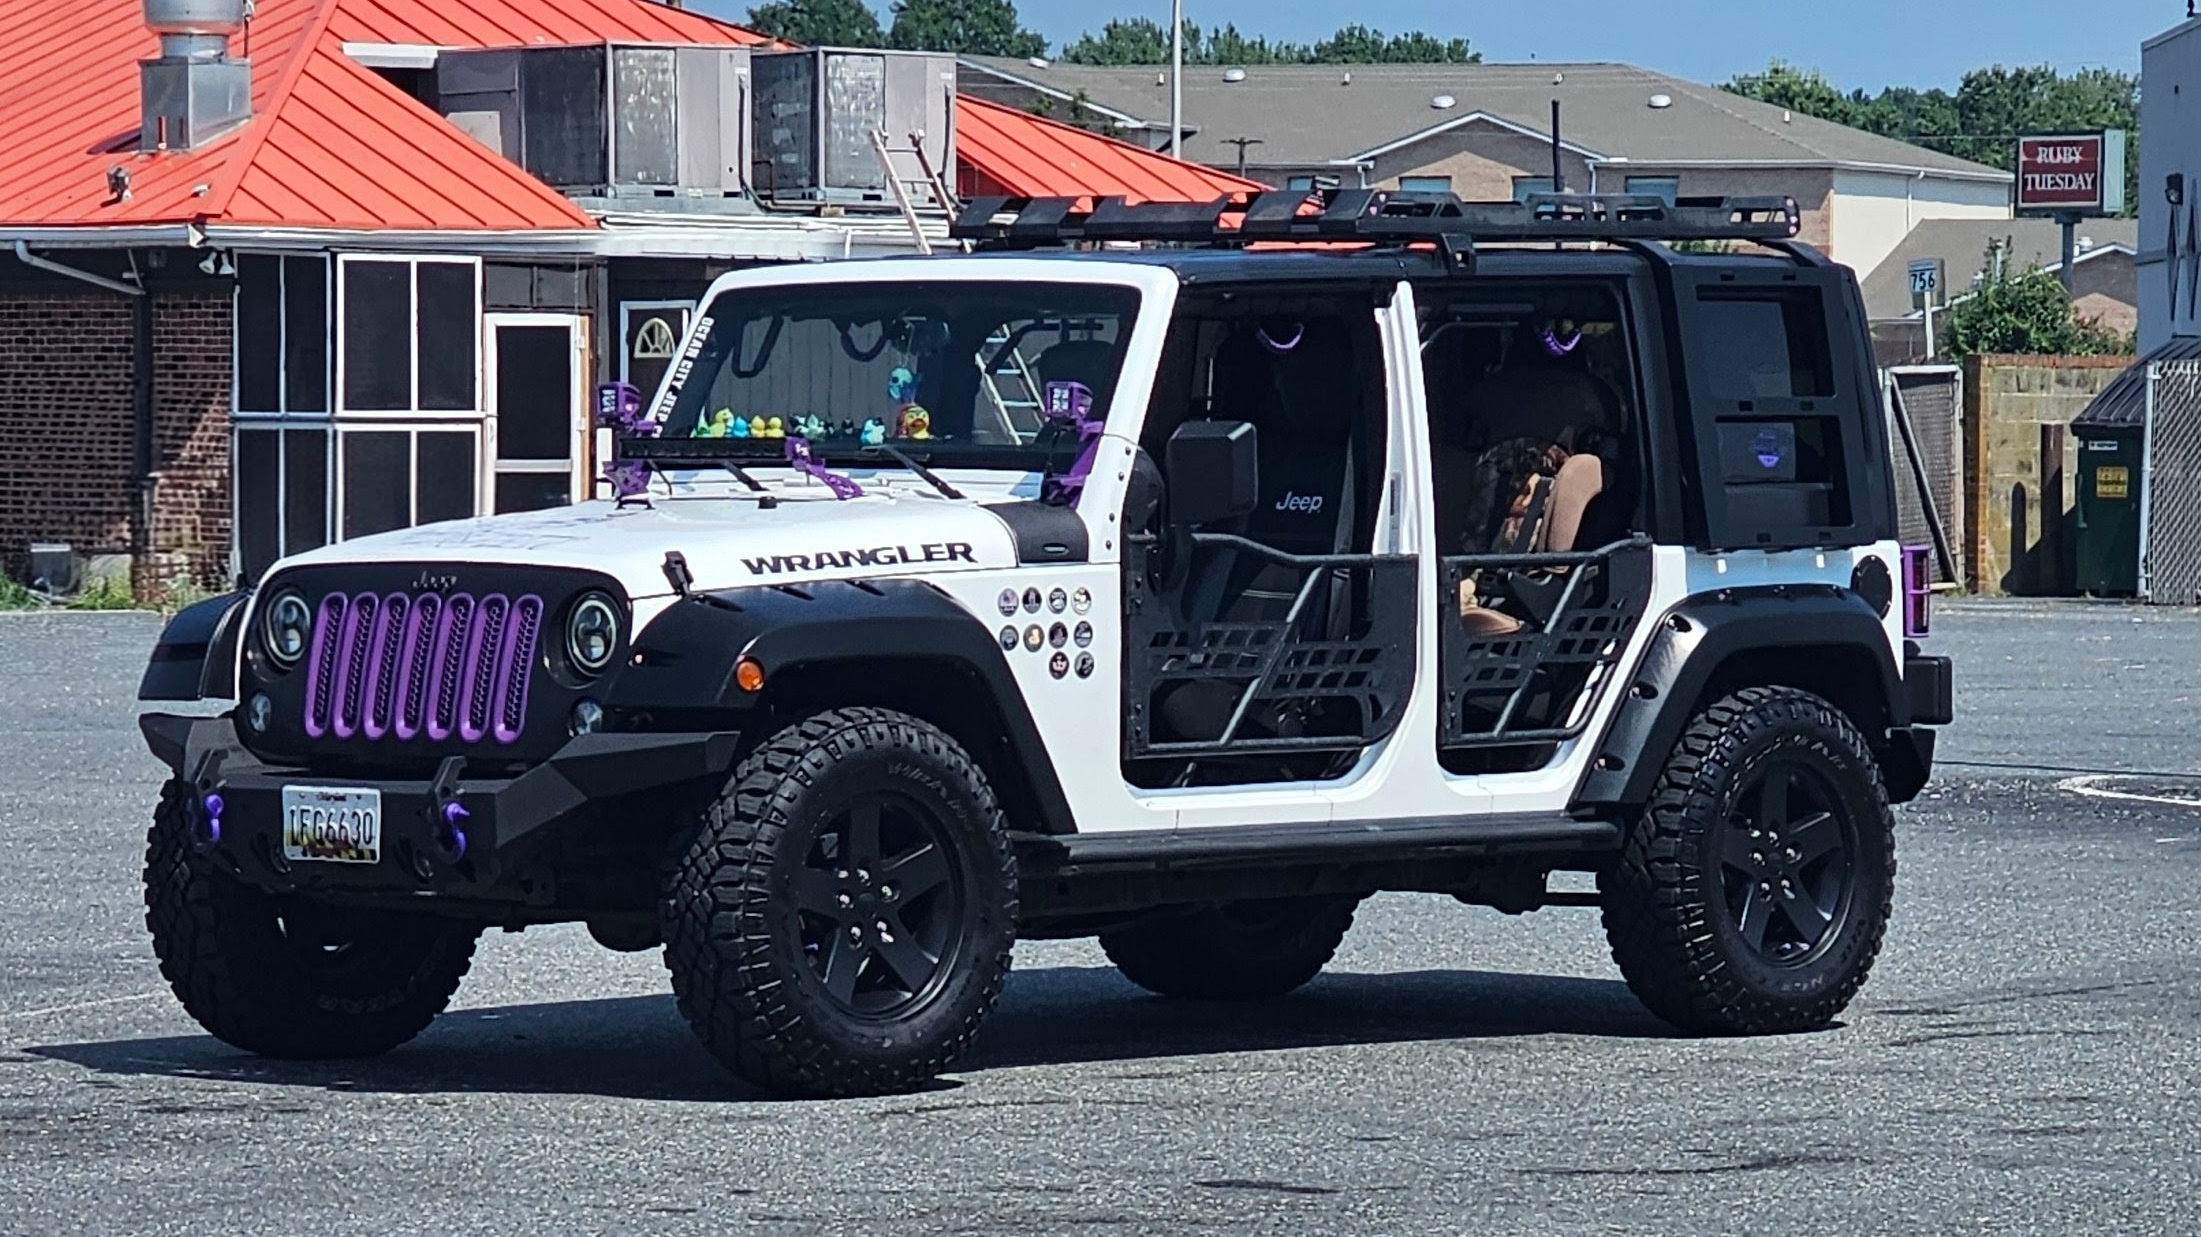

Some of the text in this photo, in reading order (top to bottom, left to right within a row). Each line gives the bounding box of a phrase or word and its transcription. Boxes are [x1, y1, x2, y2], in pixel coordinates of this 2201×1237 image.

[2037, 145, 2084, 165] RUBY
[2023, 172, 2096, 191] TUESDAY
[1910, 271, 1936, 290] 756
[685, 316, 715, 359] OCEAN
[671, 359, 694, 391] CITY
[656, 390, 678, 423] JEEP
[1275, 491, 1323, 514] Jeep
[740, 542, 978, 575] WRANGLER
